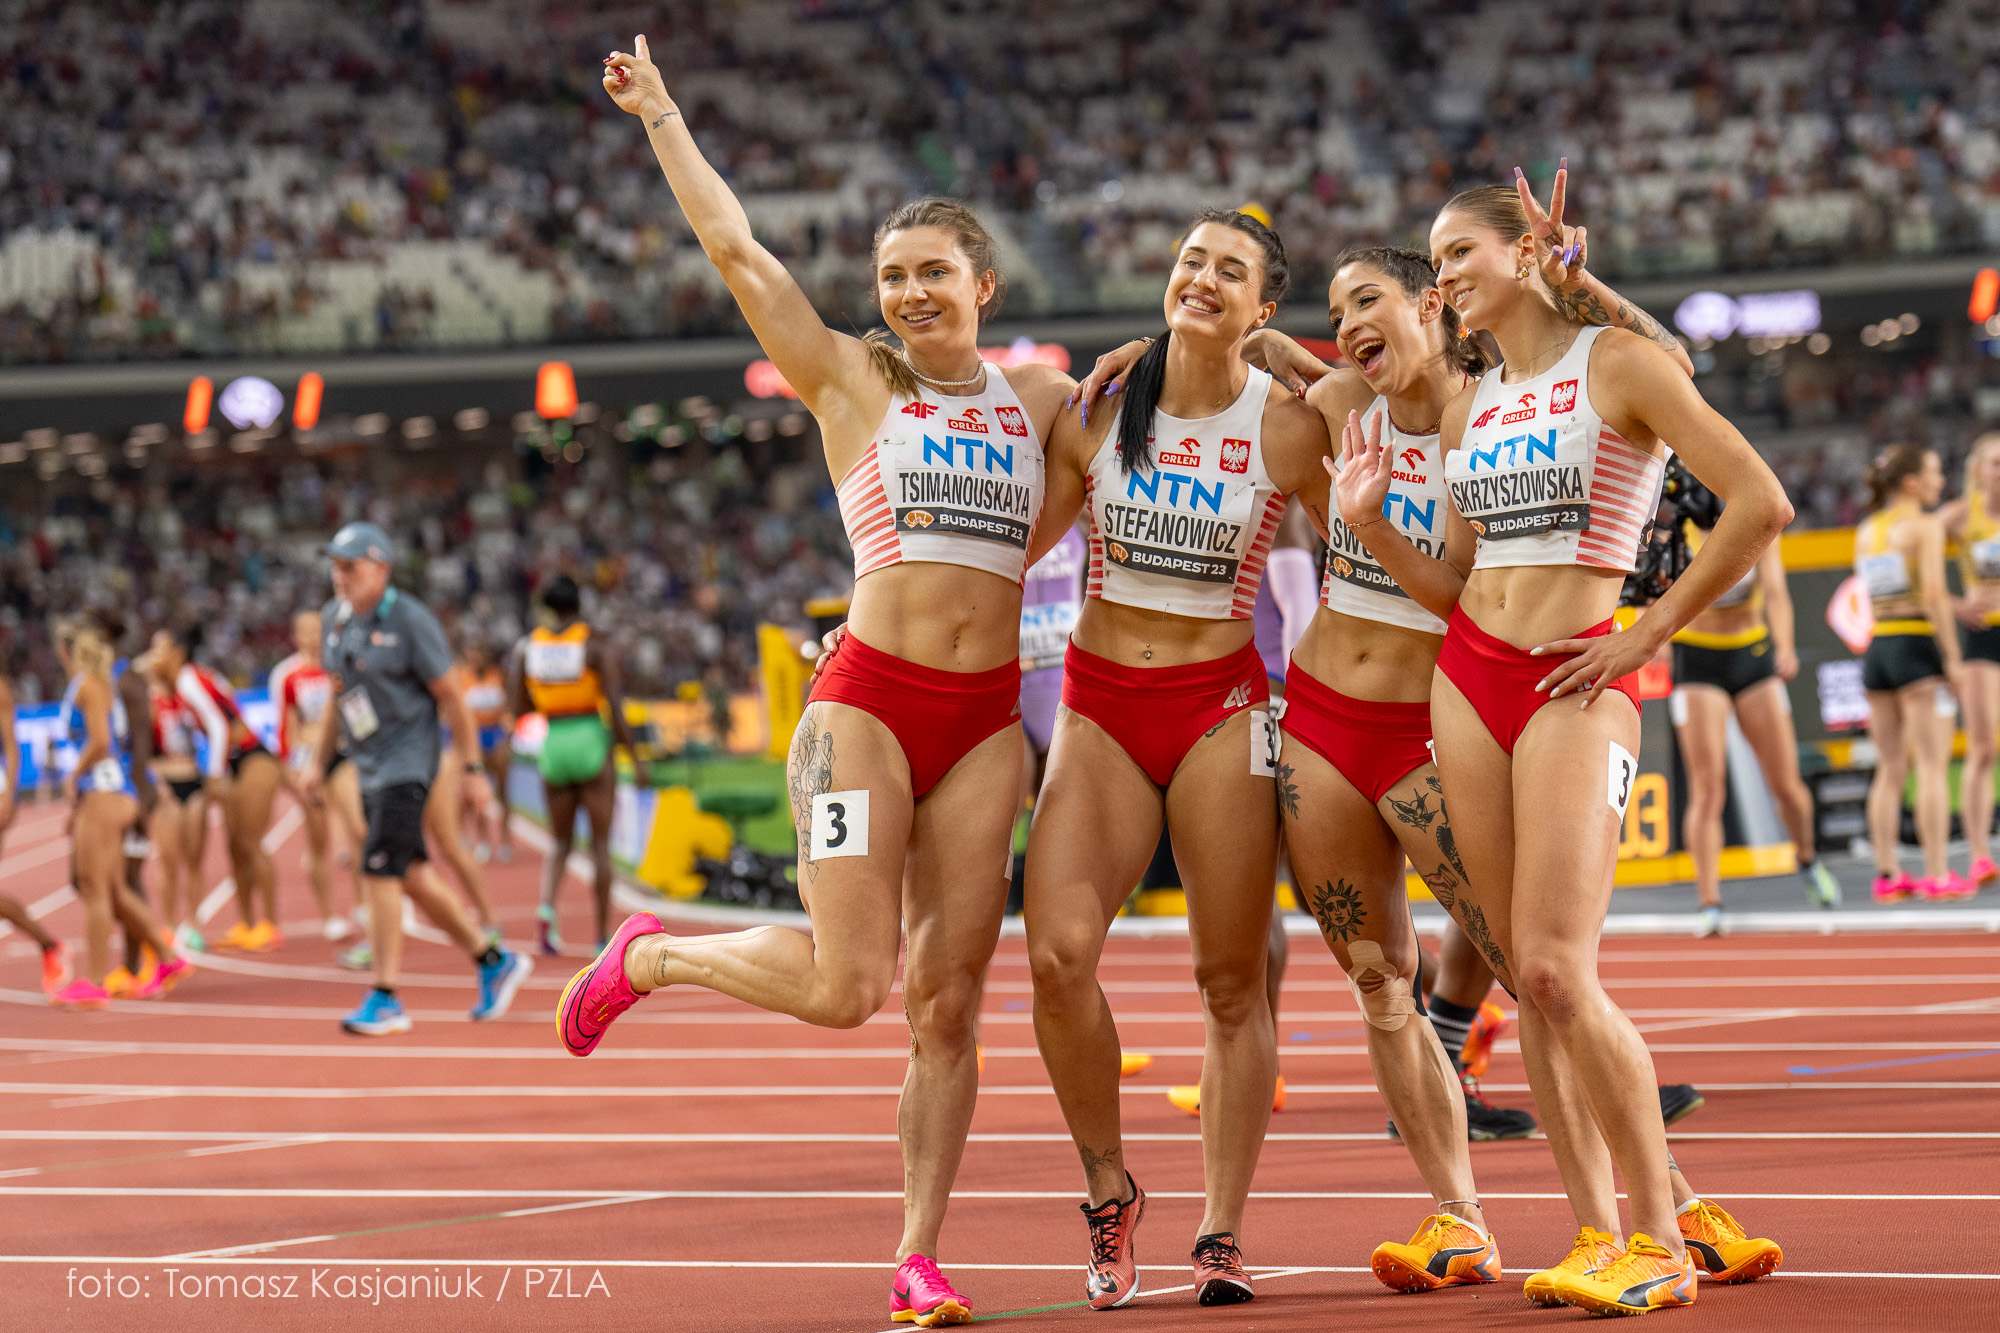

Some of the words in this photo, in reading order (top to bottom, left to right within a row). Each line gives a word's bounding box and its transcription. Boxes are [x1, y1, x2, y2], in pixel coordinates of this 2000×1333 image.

[950, 421, 986, 433] ORLEN
[1503, 410, 1534, 423] ORLEN
[923, 433, 1013, 478] NTN
[1161, 453, 1198, 466] ORLEN
[1469, 428, 1557, 473] NTN
[899, 471, 1030, 519] TSIMANOUSKAYA
[1126, 469, 1225, 516] NTN
[1390, 470, 1427, 485] ORLEN
[1451, 466, 1585, 514] SKRZYSZOWSKA
[1104, 503, 1242, 554] STEFANOWICZ
[1382, 492, 1436, 534] TN
[1618, 759, 1630, 808] 3
[826, 802, 848, 848] 3
